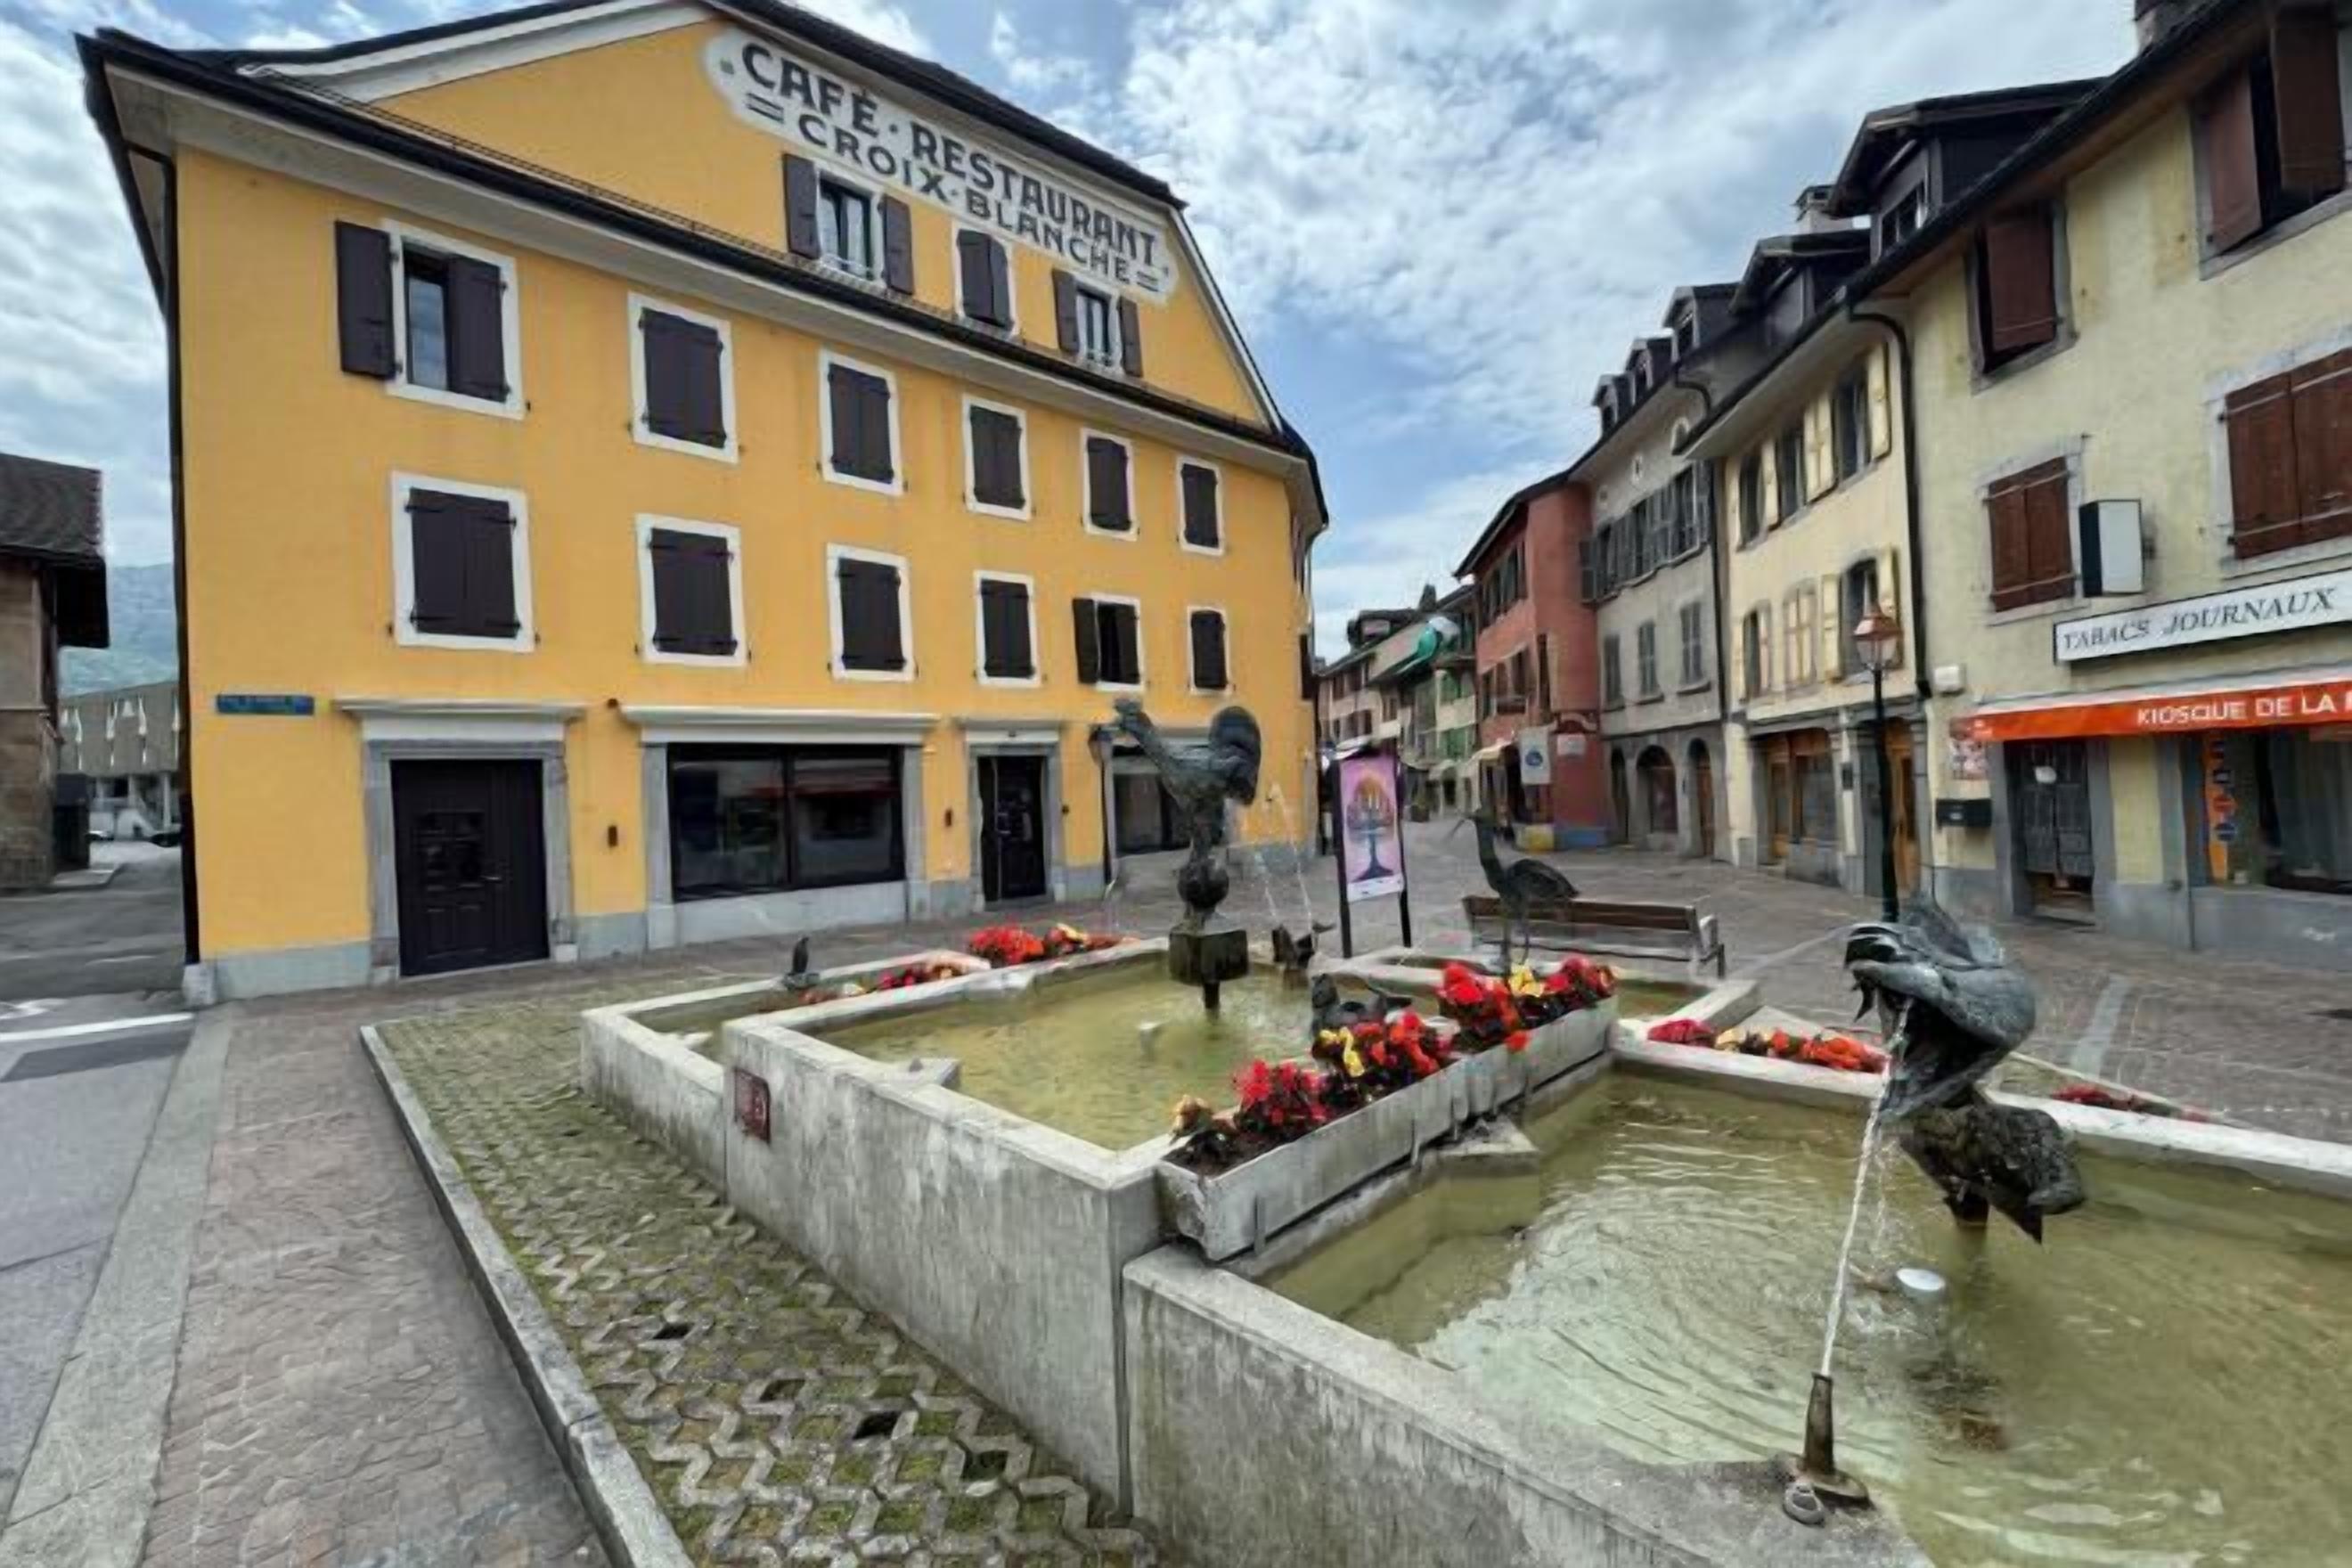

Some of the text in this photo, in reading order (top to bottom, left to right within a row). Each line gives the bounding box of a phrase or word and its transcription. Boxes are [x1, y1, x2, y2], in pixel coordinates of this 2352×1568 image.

[911, 121, 1156, 265] RESTAURANT
[2062, 586, 2338, 650] TABACS JOURNAUX
[2138, 699, 2248, 725] KIOSQUE
[2255, 696, 2294, 717] DE
[2300, 690, 2339, 715] LA
